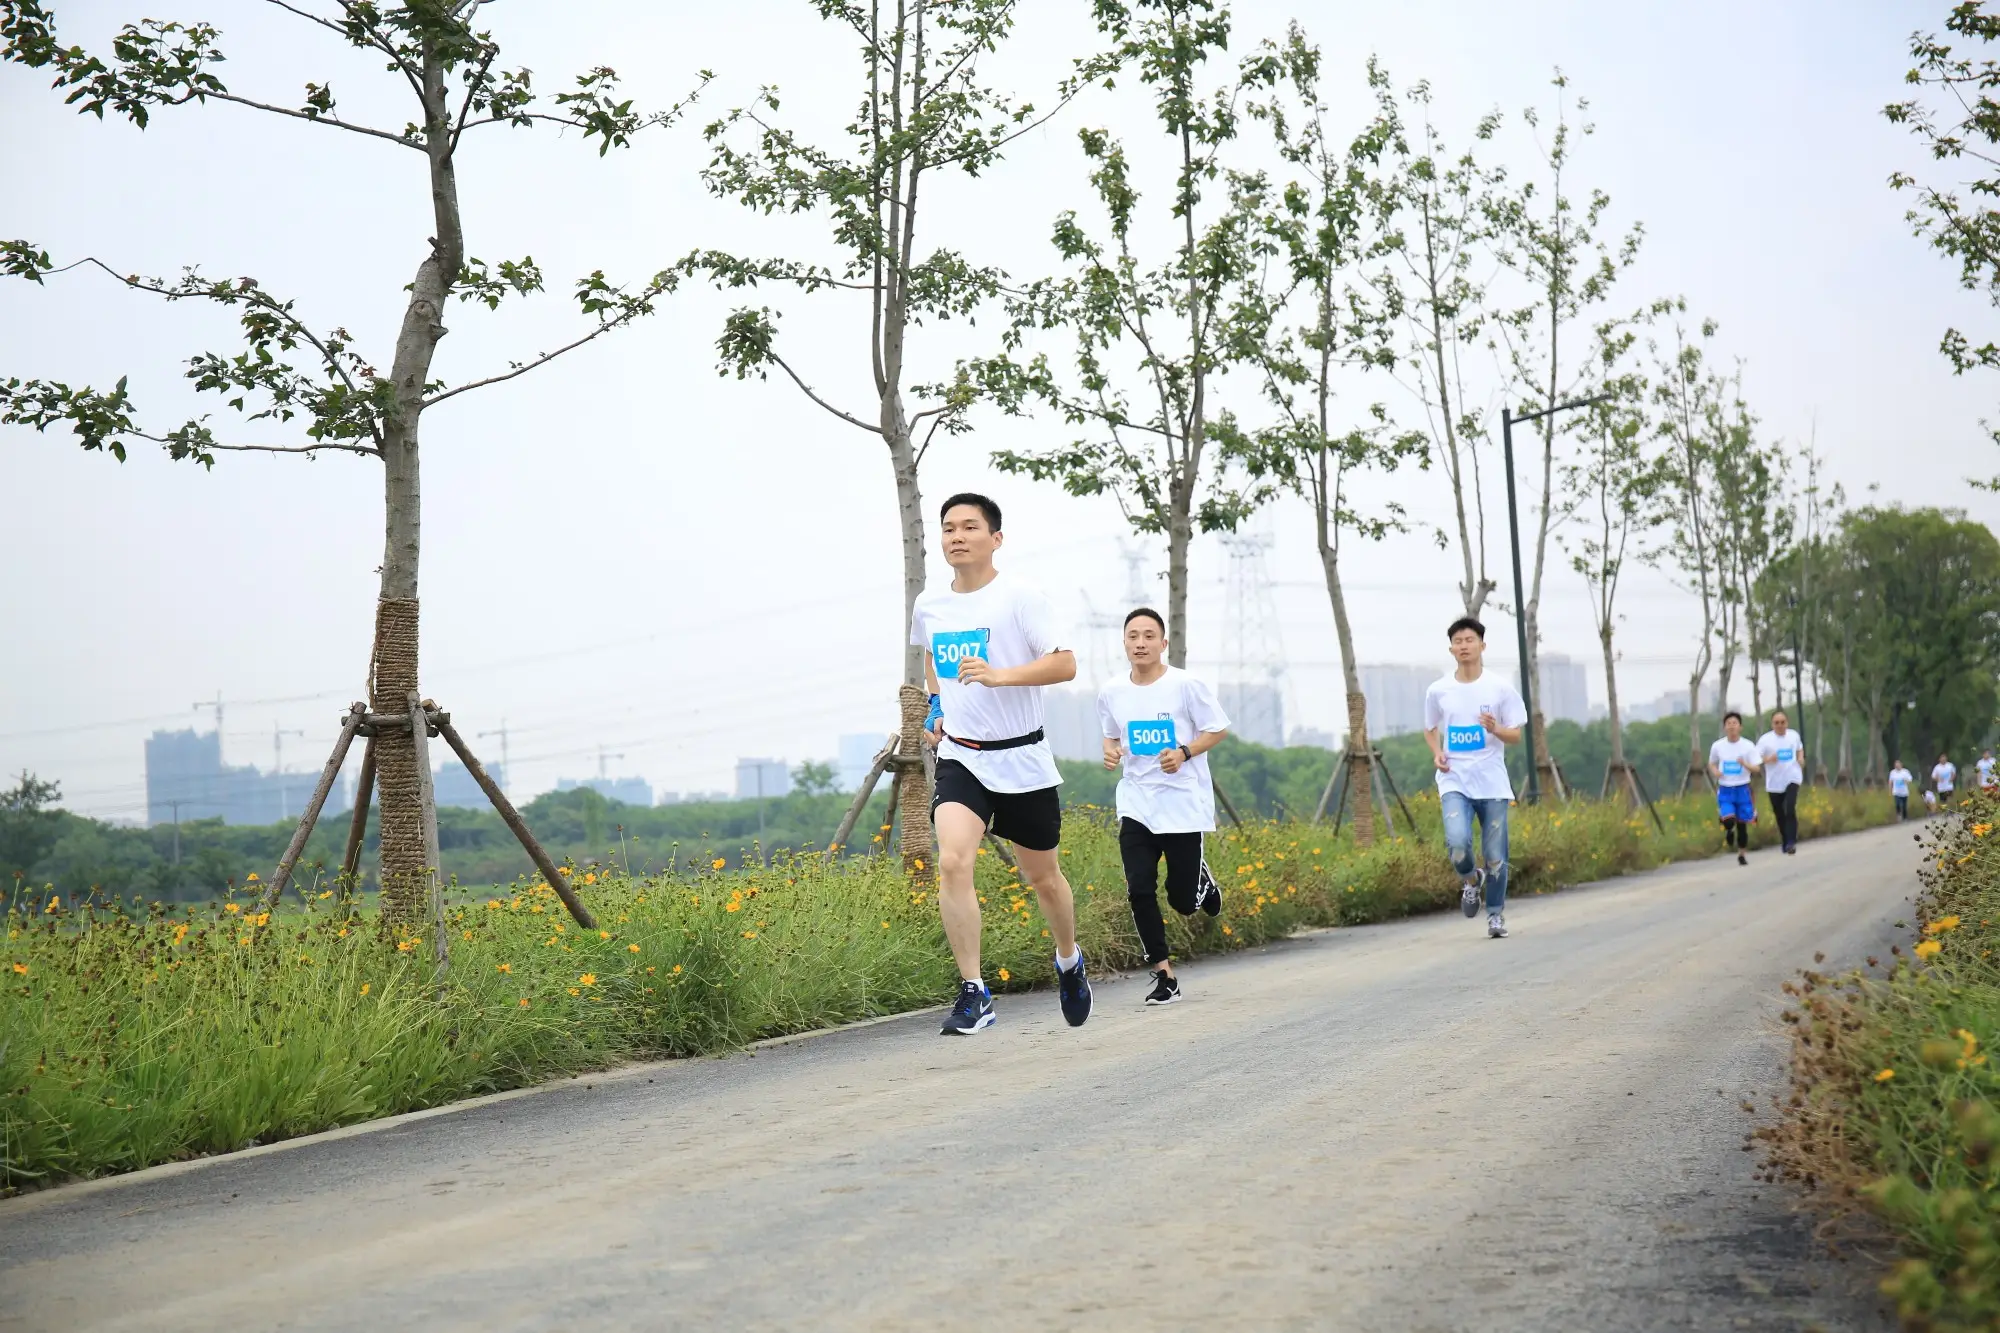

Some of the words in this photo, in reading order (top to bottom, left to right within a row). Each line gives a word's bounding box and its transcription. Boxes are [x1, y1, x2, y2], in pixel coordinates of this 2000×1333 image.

[937, 643, 981, 663] 5007
[1133, 729, 1171, 744] 5001
[1450, 731, 1481, 744] 5004
